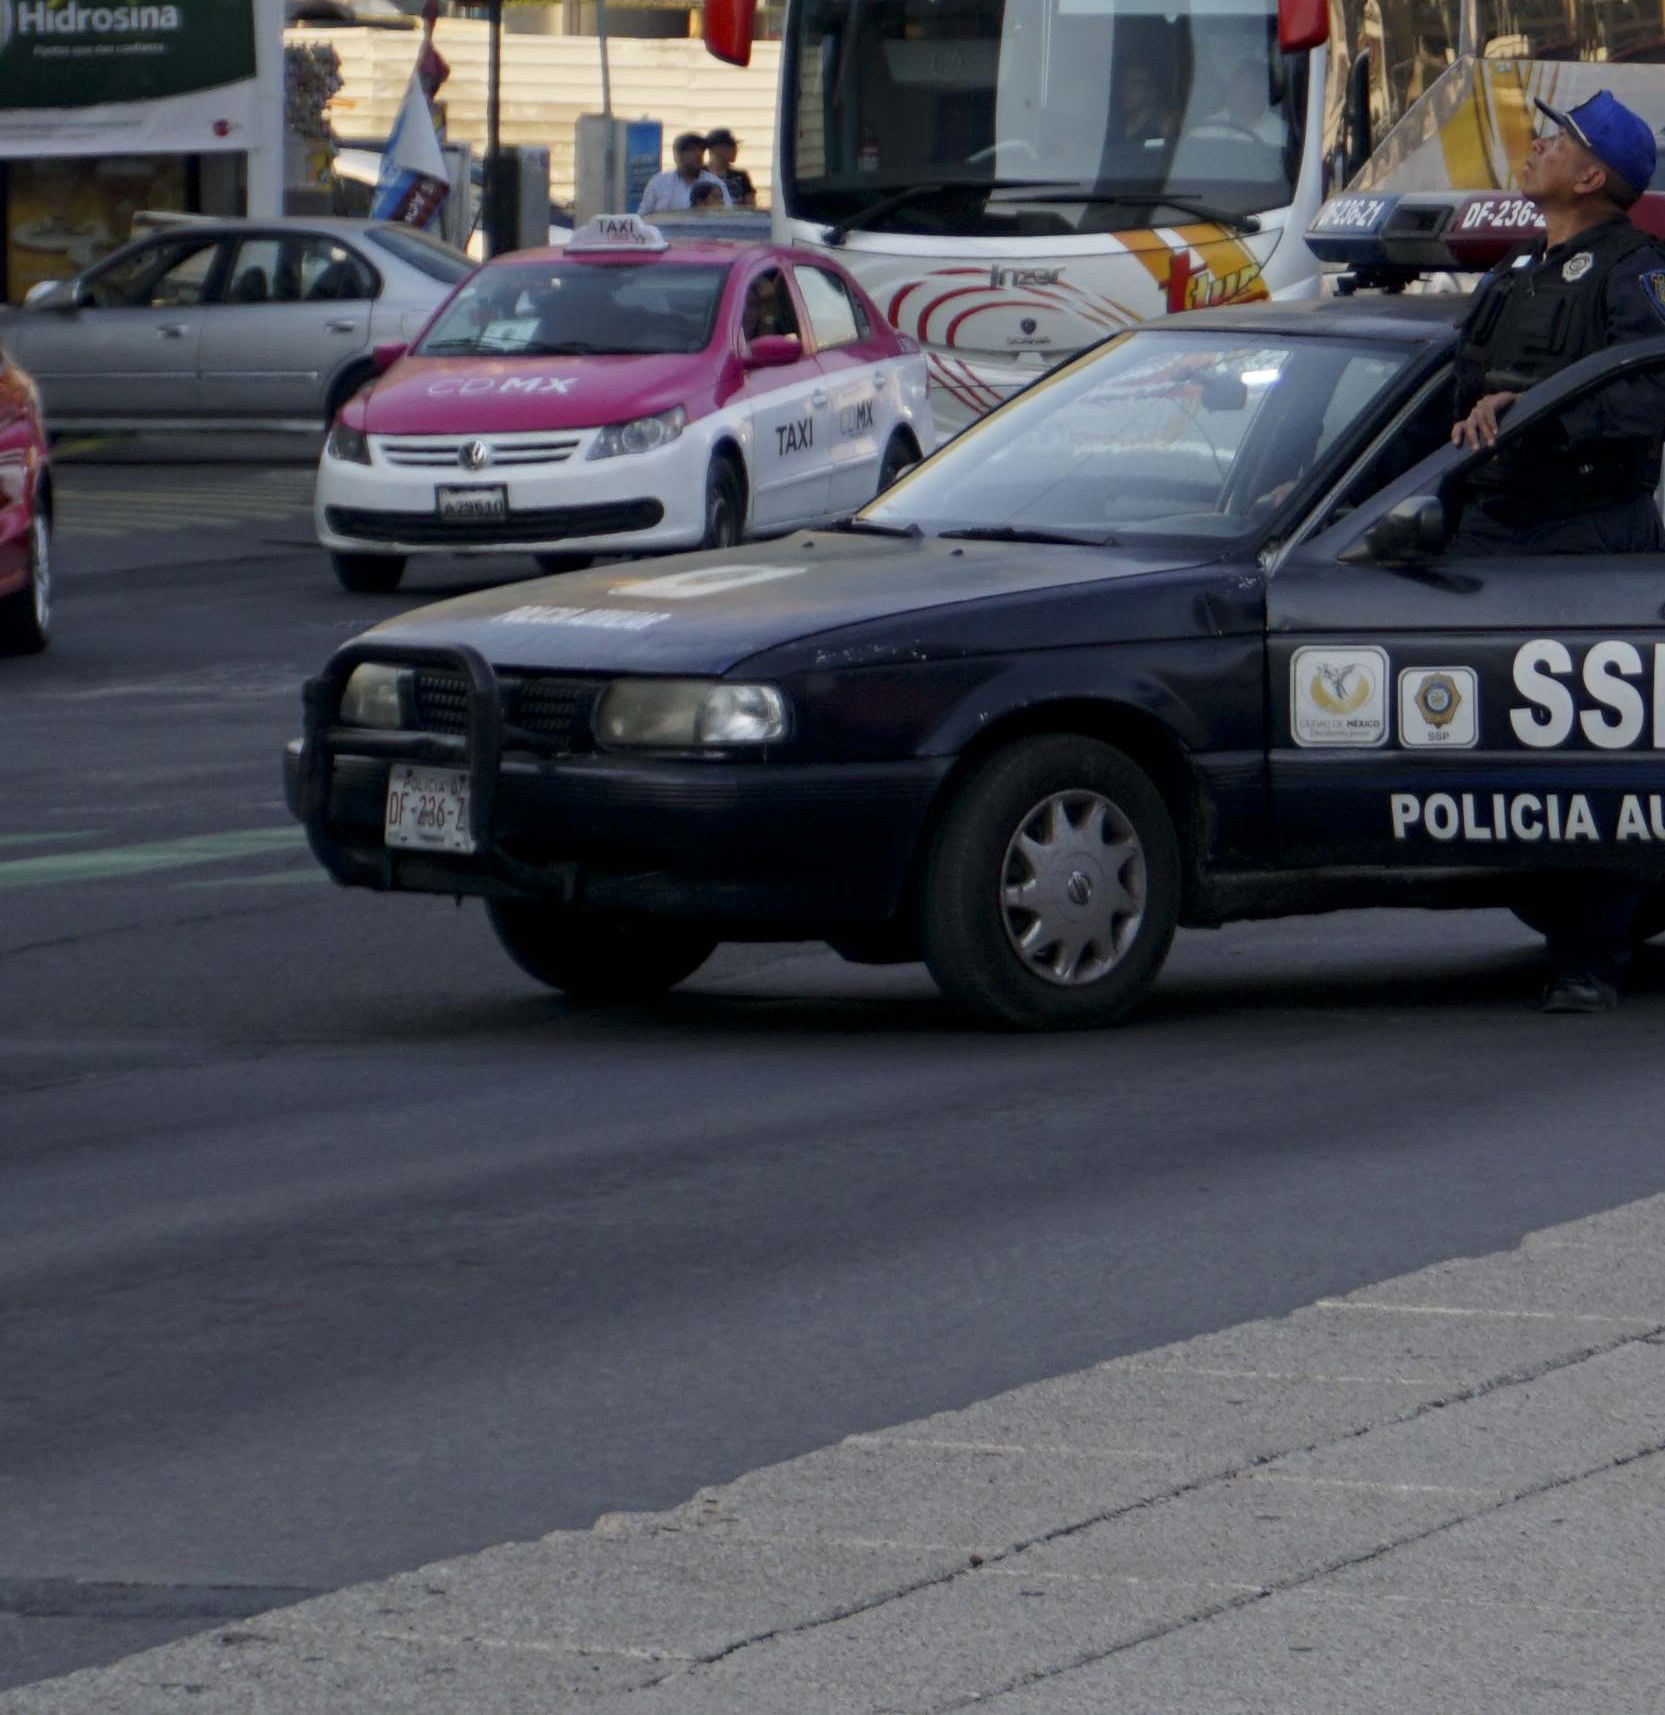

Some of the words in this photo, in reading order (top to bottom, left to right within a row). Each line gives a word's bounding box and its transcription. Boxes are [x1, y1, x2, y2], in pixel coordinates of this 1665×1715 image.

[18, 0, 181, 34] Hidrosina
[597, 219, 634, 234] TAXI
[427, 376, 581, 397] CDMX
[775, 415, 814, 457] TAXI
[1427, 731, 1450, 741] SSP
[1391, 793, 1599, 841] POLICIA
